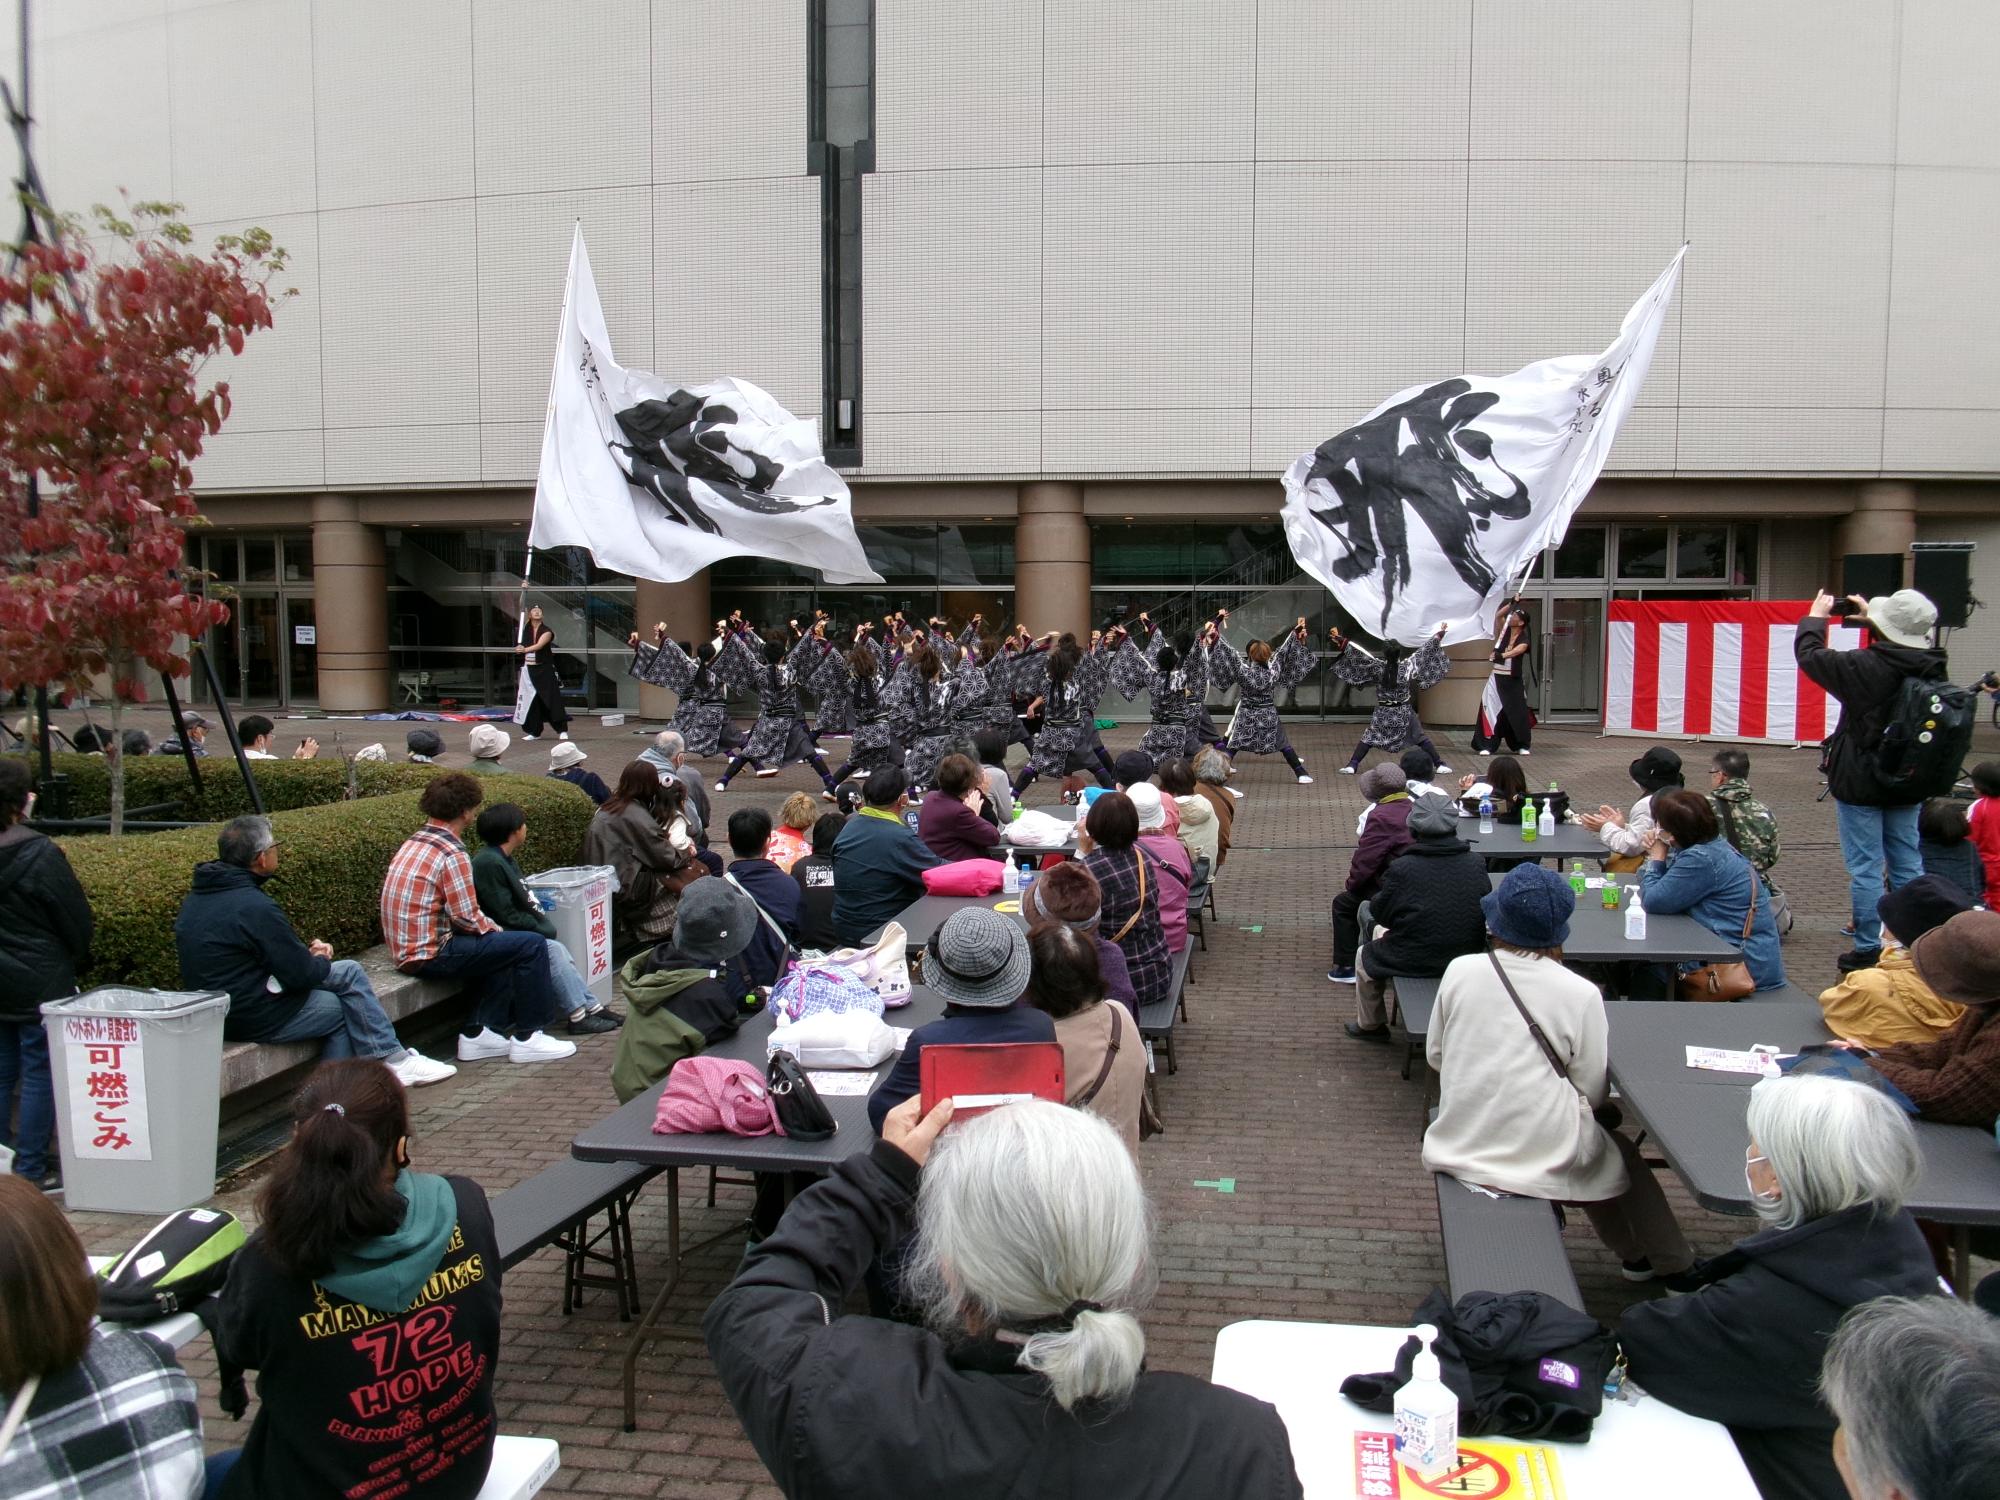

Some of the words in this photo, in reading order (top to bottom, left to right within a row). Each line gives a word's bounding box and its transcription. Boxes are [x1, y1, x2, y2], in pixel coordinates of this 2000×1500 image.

[588, 900, 607, 976] 可燃ごみ
[83, 1043, 133, 1151] 可燃ごみ
[300, 1253, 485, 1340] MAXUMS
[352, 1305, 456, 1377] 72
[350, 1341, 473, 1418] HOPE
[328, 1415, 423, 1443] PLANNING
